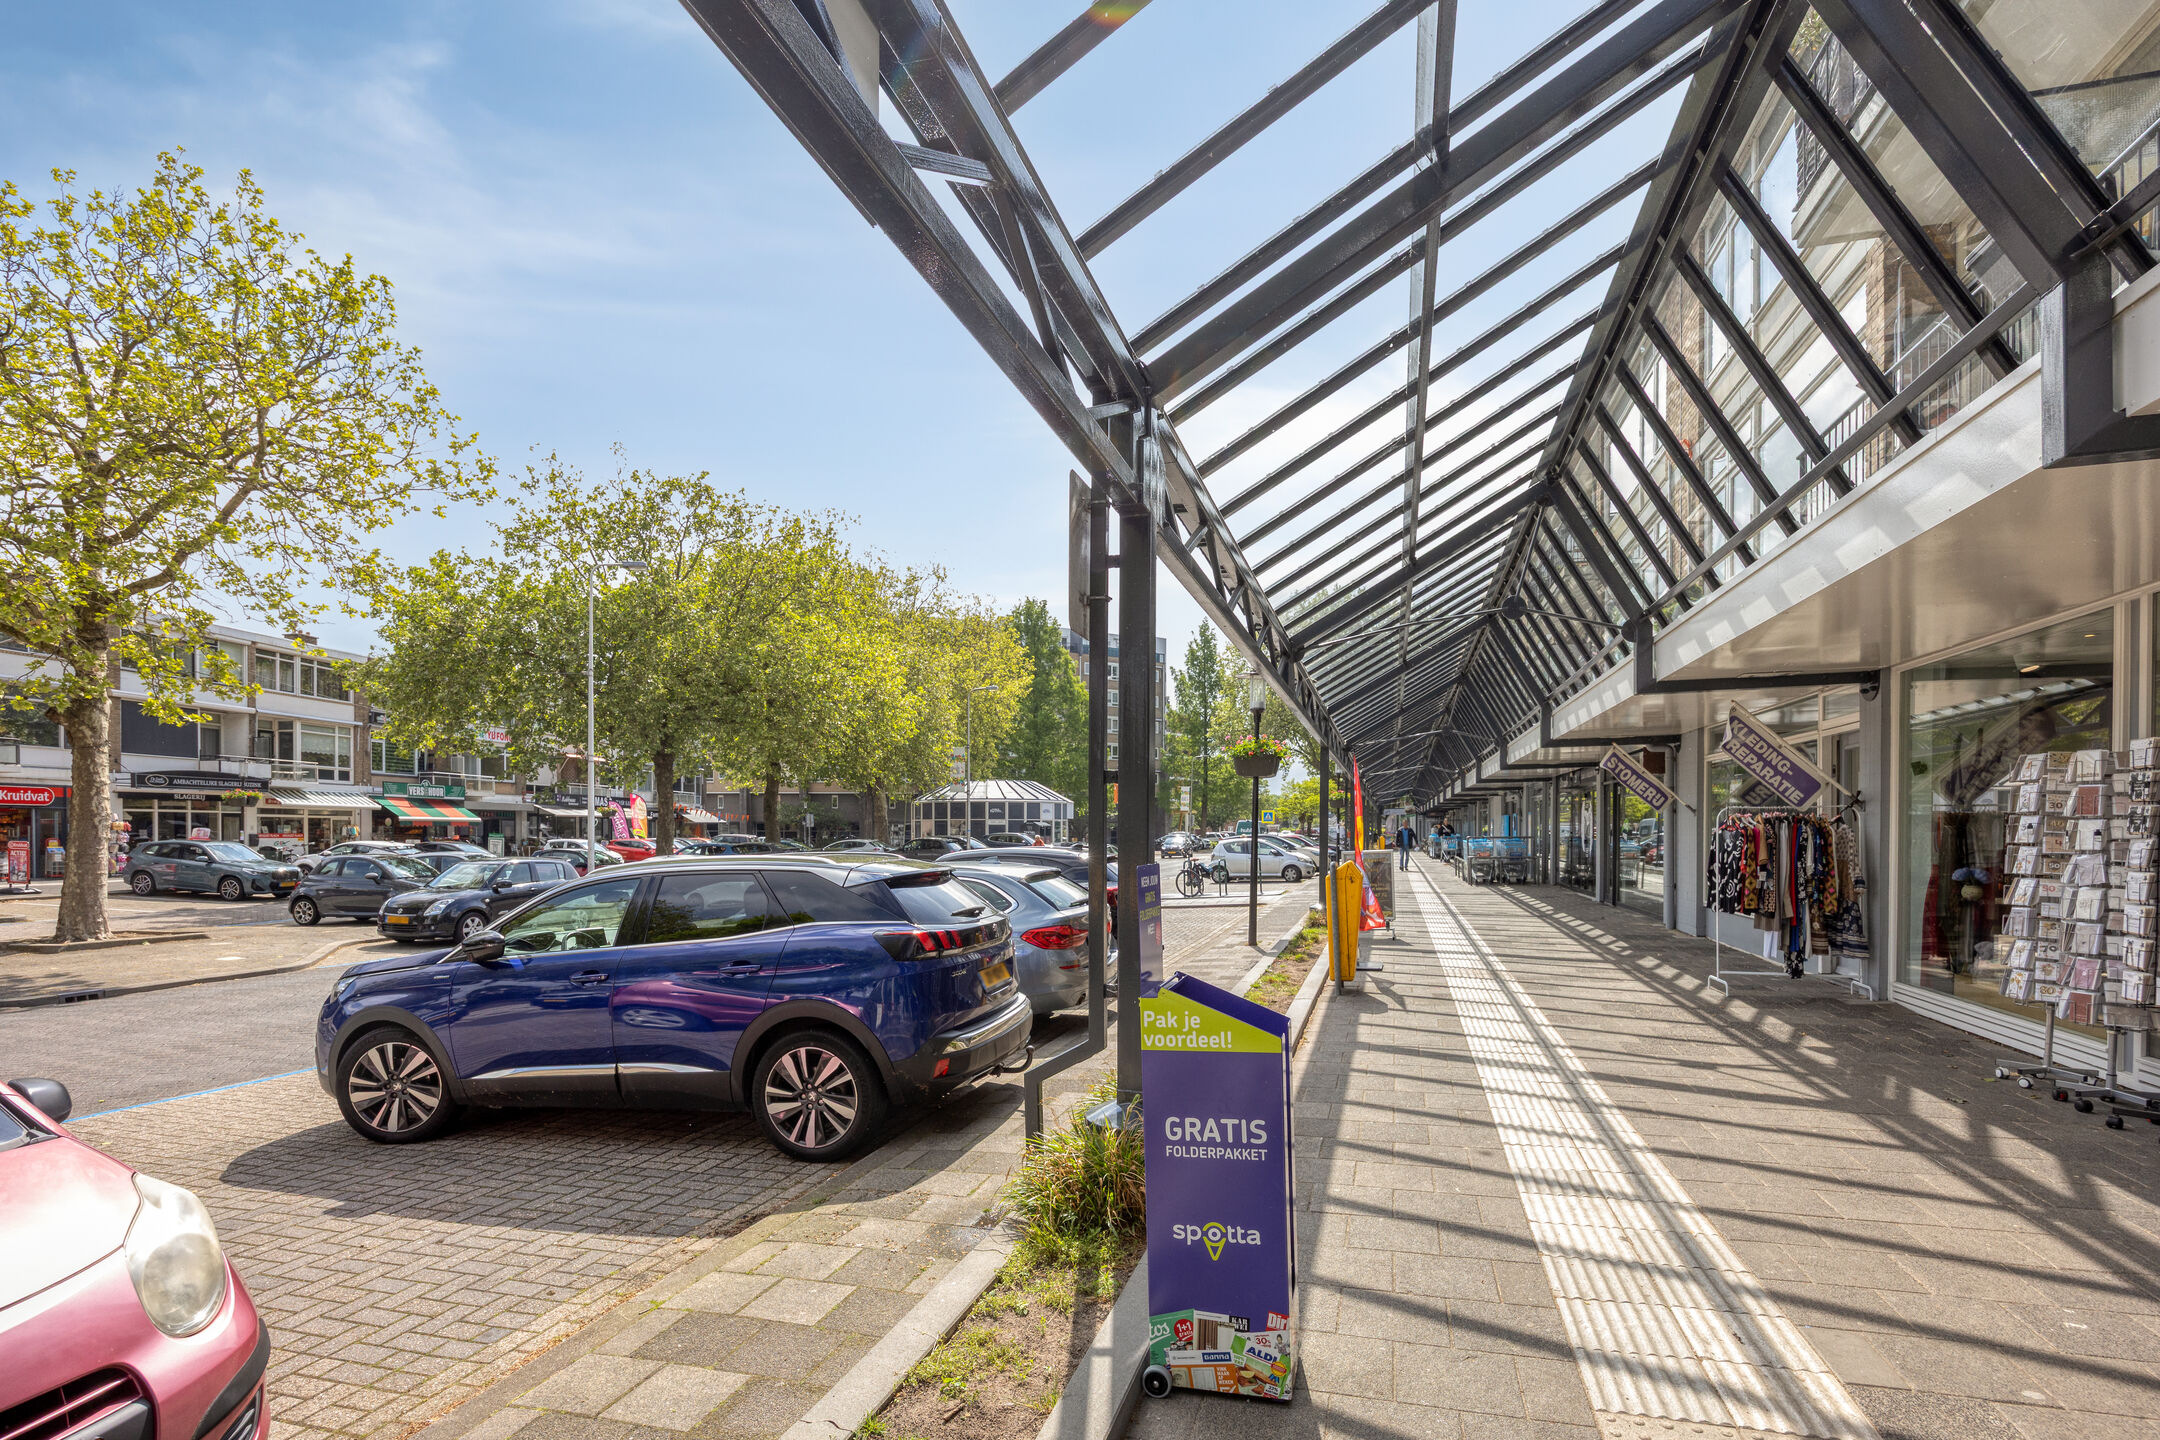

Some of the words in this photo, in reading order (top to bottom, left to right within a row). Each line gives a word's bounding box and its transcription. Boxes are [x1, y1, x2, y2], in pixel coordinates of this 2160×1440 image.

[1731, 720, 1793, 776] KLEDING-
[1726, 739, 1804, 804] REPARATIE
[0, 790, 50, 802] Kruidvat
[1143, 1010, 1178, 1028] Pak
[1182, 1011, 1200, 1032] je
[1143, 1030, 1232, 1048] voordeel!
[1165, 1116, 1267, 1144] GRATIS
[1165, 1145, 1268, 1161] FOLDERPAKKET
[1172, 1224, 1261, 1245] spotta
[1177, 1321, 1192, 1332] 1+1
[1246, 1346, 1278, 1362] ALDI
